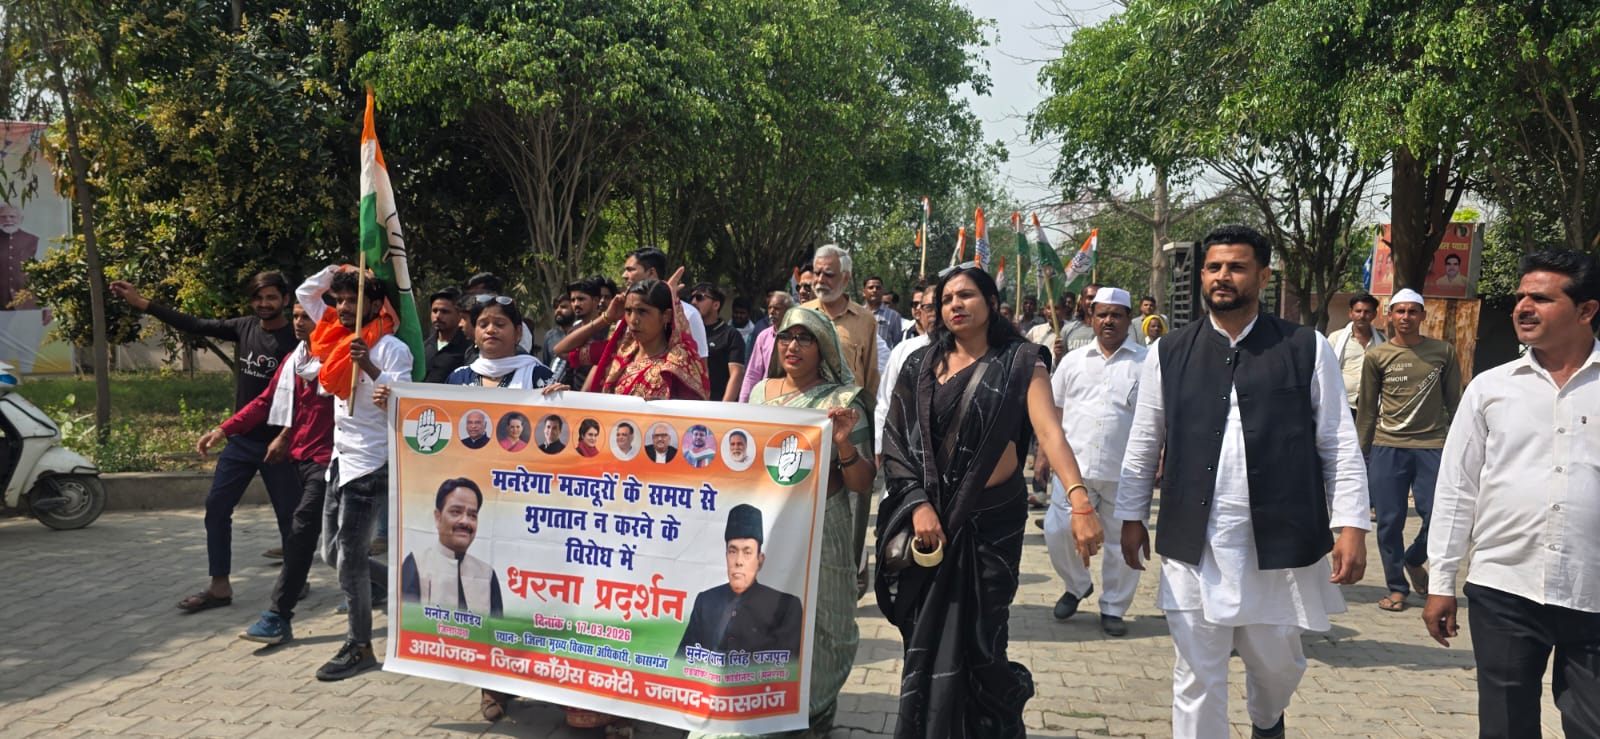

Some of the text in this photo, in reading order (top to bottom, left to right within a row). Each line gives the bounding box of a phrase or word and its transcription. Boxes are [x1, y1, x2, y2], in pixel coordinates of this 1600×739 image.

[492, 466, 718, 511] मनरेगा मजदूरों के समय से
[525, 506, 681, 542] भुगतान न करने के
[619, 544, 637, 571] में
[507, 566, 687, 622] धरना प्रदर्शन
[424, 604, 482, 627] मनोज पाण्डेय
[534, 613, 564, 630] दिनांक
[575, 621, 631, 641] 17.03.2026
[409, 638, 486, 663] आयोजक-
[490, 648, 529, 674] जिला
[533, 657, 586, 685] काँग्रेस
[588, 668, 639, 697] कमेटी,
[524, 632, 546, 647] जिला
[549, 638, 567, 652] मुख्य
[569, 640, 594, 656] विकास
[597, 645, 632, 665] अधिकारी,
[634, 653, 669, 669] कासगंज
[729, 649, 750, 667] सिंह
[753, 650, 791, 667] राजपूत
